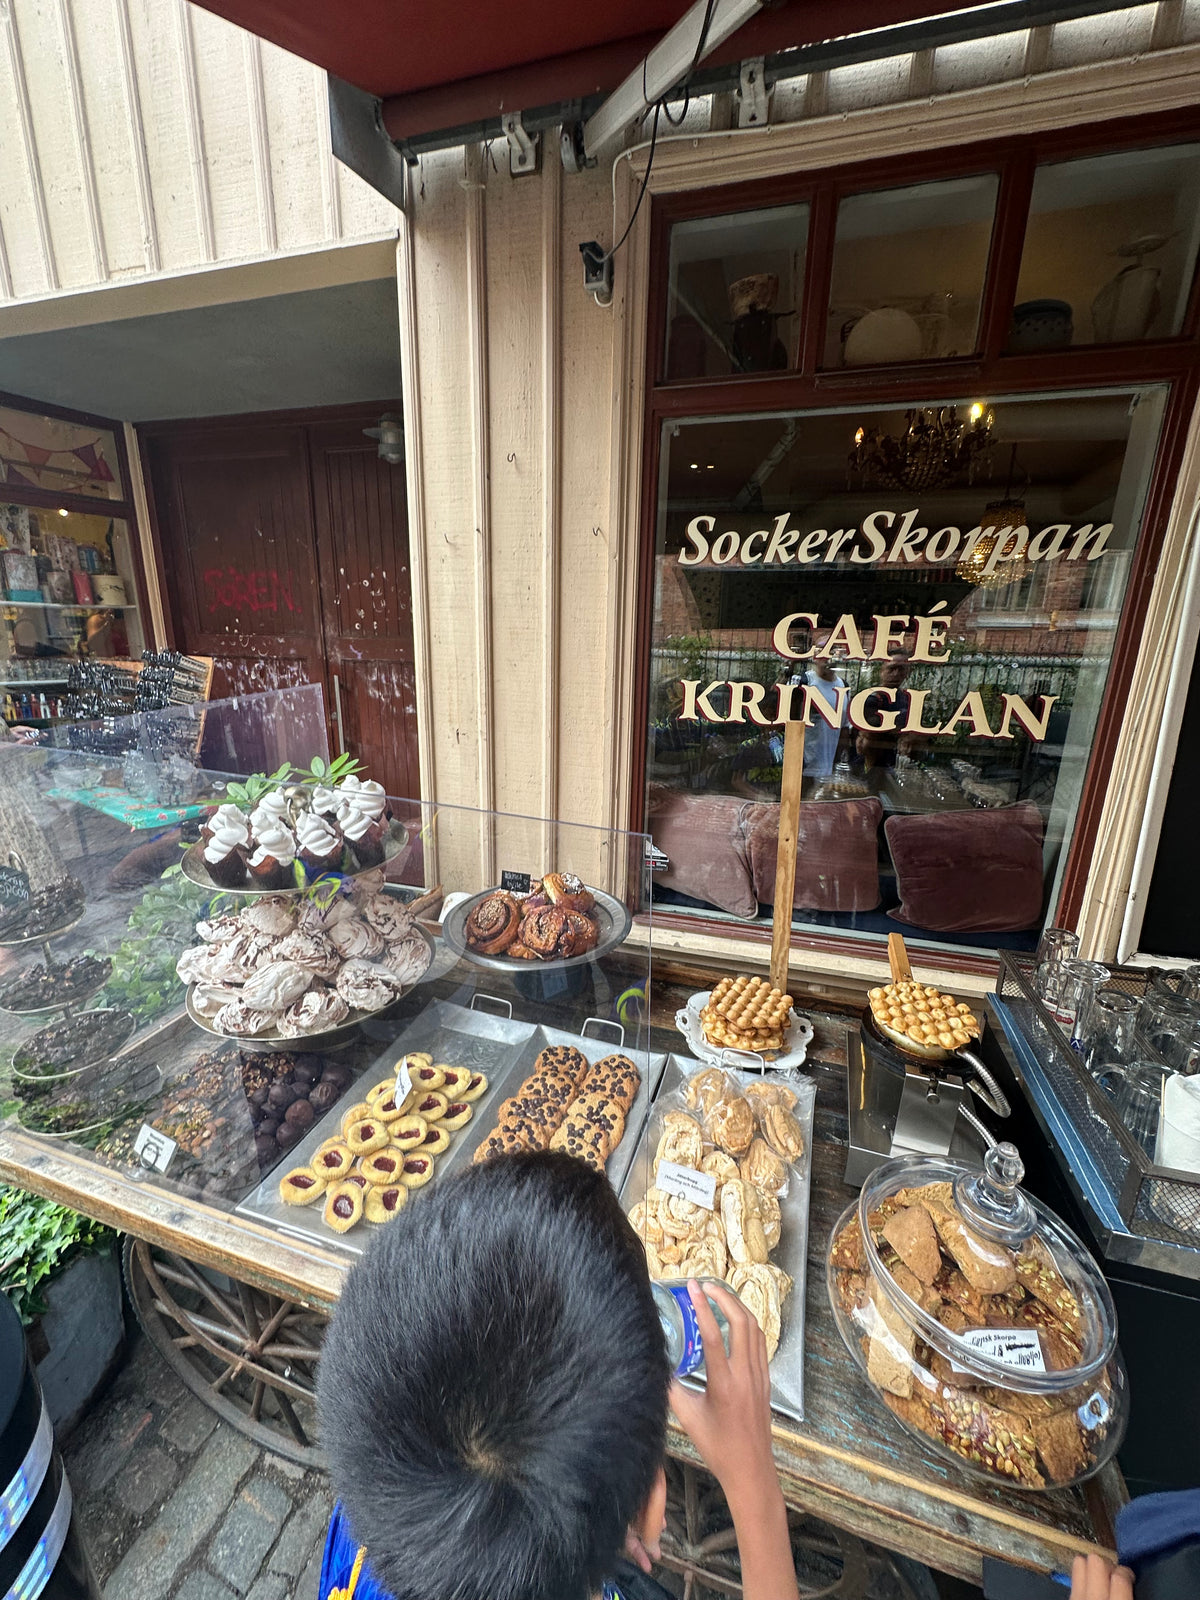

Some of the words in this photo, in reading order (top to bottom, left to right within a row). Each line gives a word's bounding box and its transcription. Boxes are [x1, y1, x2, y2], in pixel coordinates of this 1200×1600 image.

[678, 508, 1114, 576] SockerSkorpan
[772, 600, 952, 663] CAFÉ
[678, 679, 1060, 743] KRINGLAN
